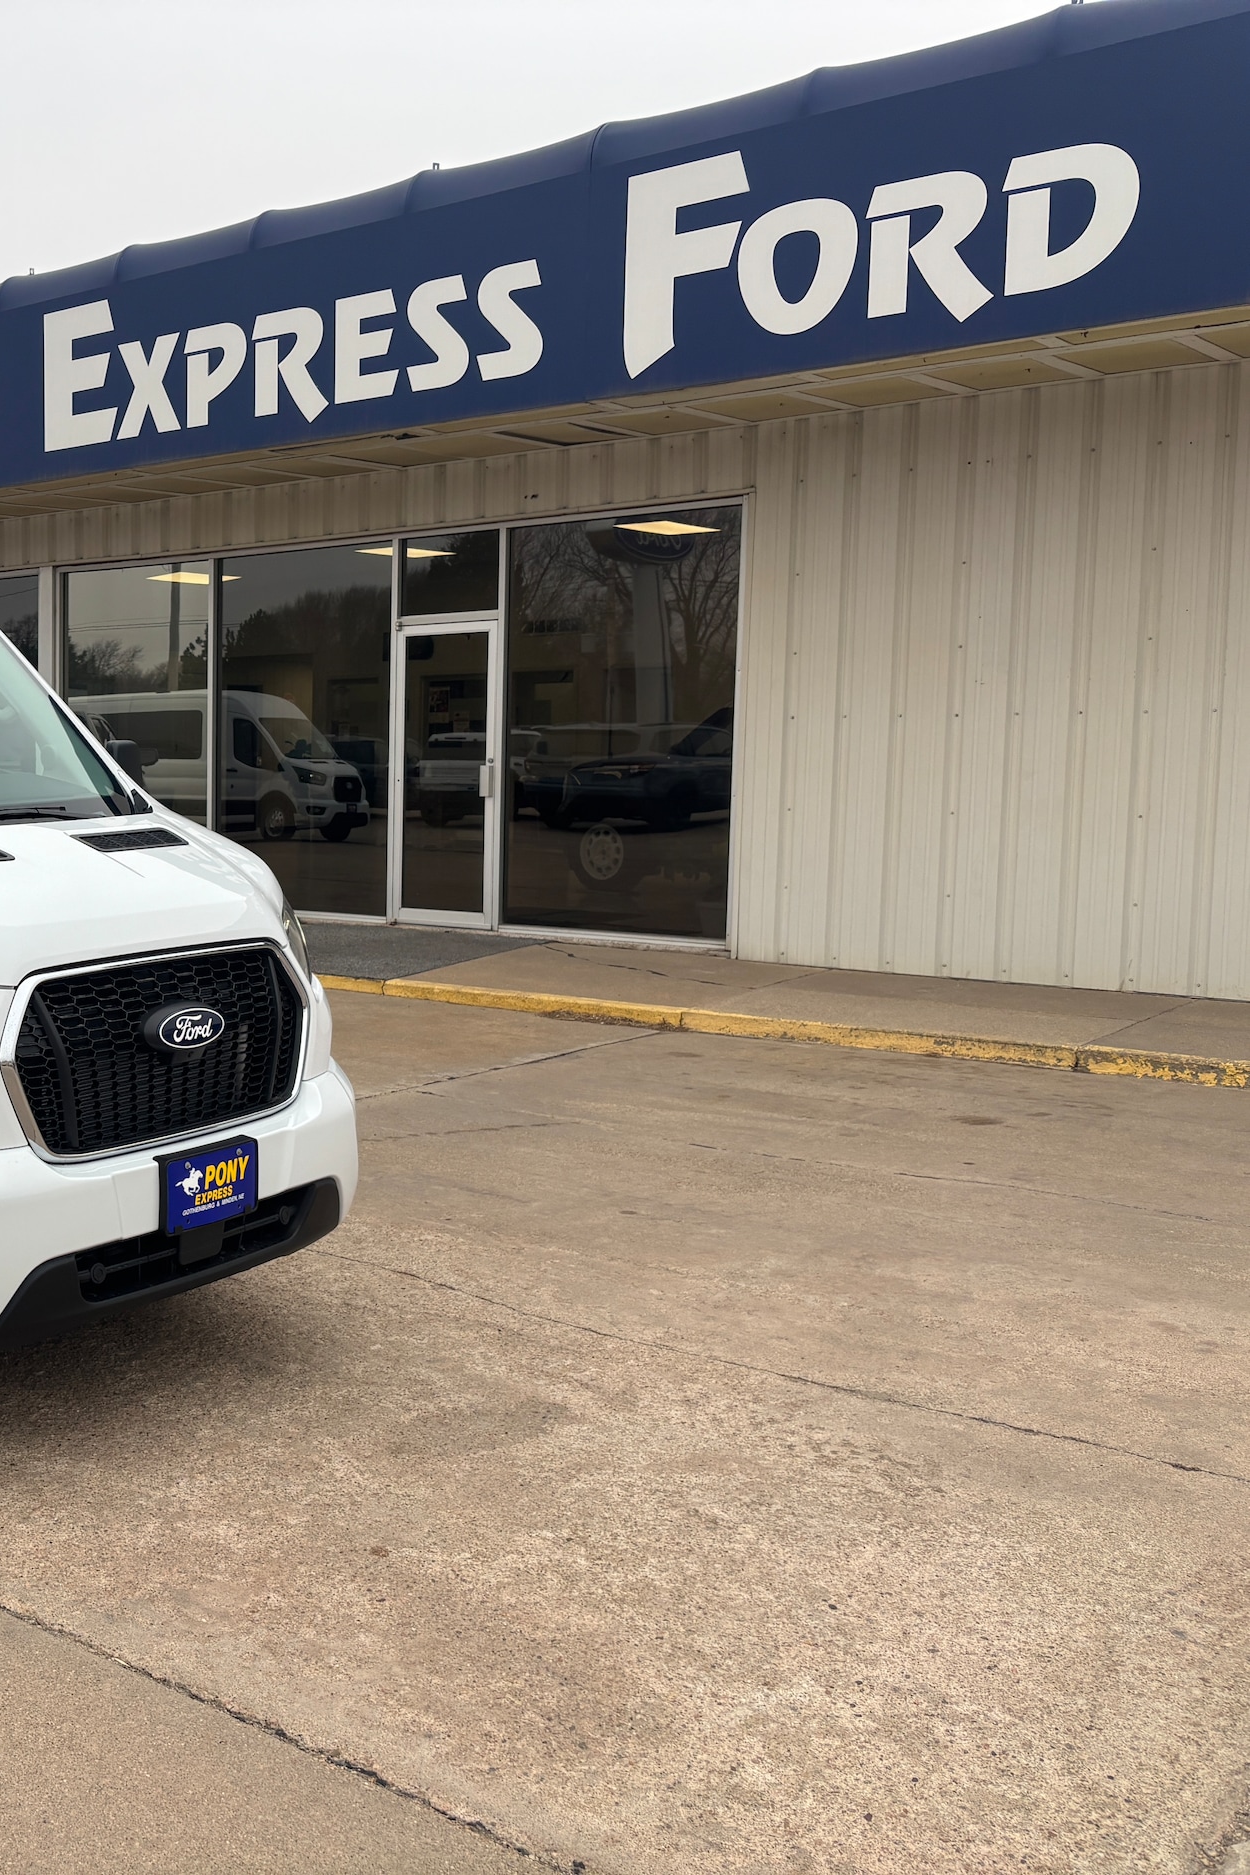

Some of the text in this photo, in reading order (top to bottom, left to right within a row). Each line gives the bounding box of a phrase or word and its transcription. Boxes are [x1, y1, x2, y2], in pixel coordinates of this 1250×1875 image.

[43, 258, 545, 453] EXPRESS
[622, 142, 1141, 380] FORD
[173, 1014, 213, 1043] Ford
[204, 1155, 249, 1190] PONY
[182, 1202, 216, 1216] GOTHENBURG
[194, 1184, 234, 1206] EXPRESS
